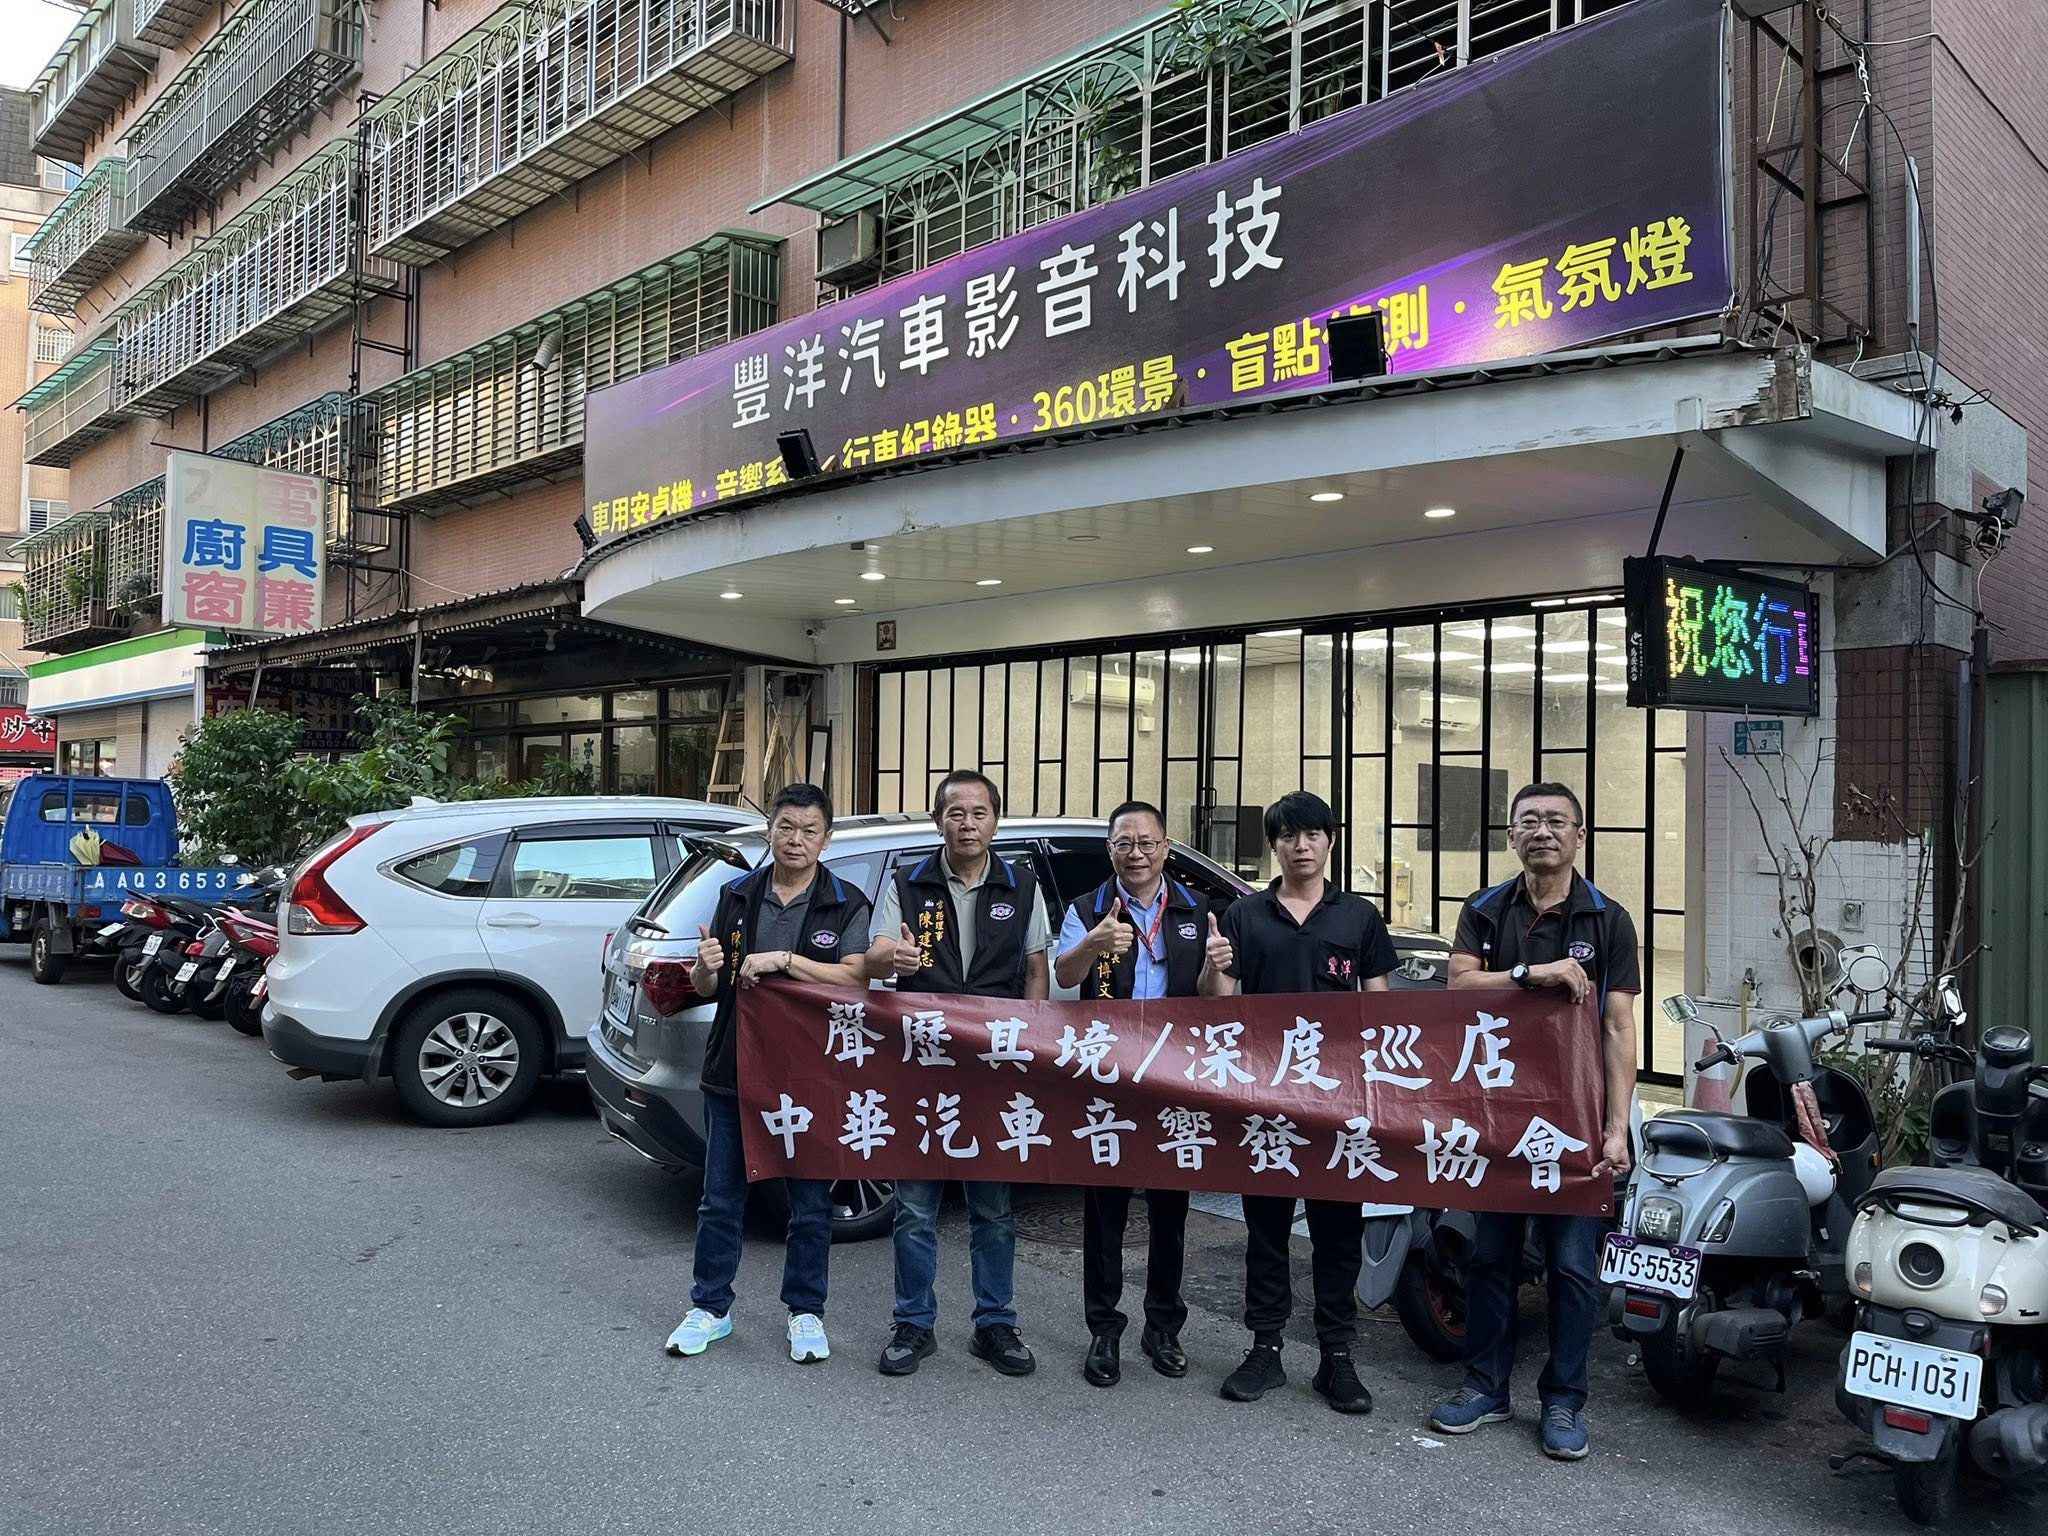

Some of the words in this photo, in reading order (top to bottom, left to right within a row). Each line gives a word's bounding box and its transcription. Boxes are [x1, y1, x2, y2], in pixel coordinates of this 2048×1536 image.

[731, 177, 1284, 429] 豐洋汽車影音科技
[842, 402, 998, 469] 行車紀錄器
[1033, 354, 1178, 433] 360環景
[1225, 284, 1429, 393] 盲點測
[1491, 216, 1694, 331] 氣氛燈
[182, 517, 318, 579] 廚具
[181, 570, 316, 630] 窗簾
[824, 1001, 1516, 1091] 聲歷其境/深度巡店
[760, 1088, 1590, 1193] 中華汽車音響發展協會
[1604, 1247, 1696, 1288] NTS-5533
[1852, 1348, 1970, 1402] PCH-1031
